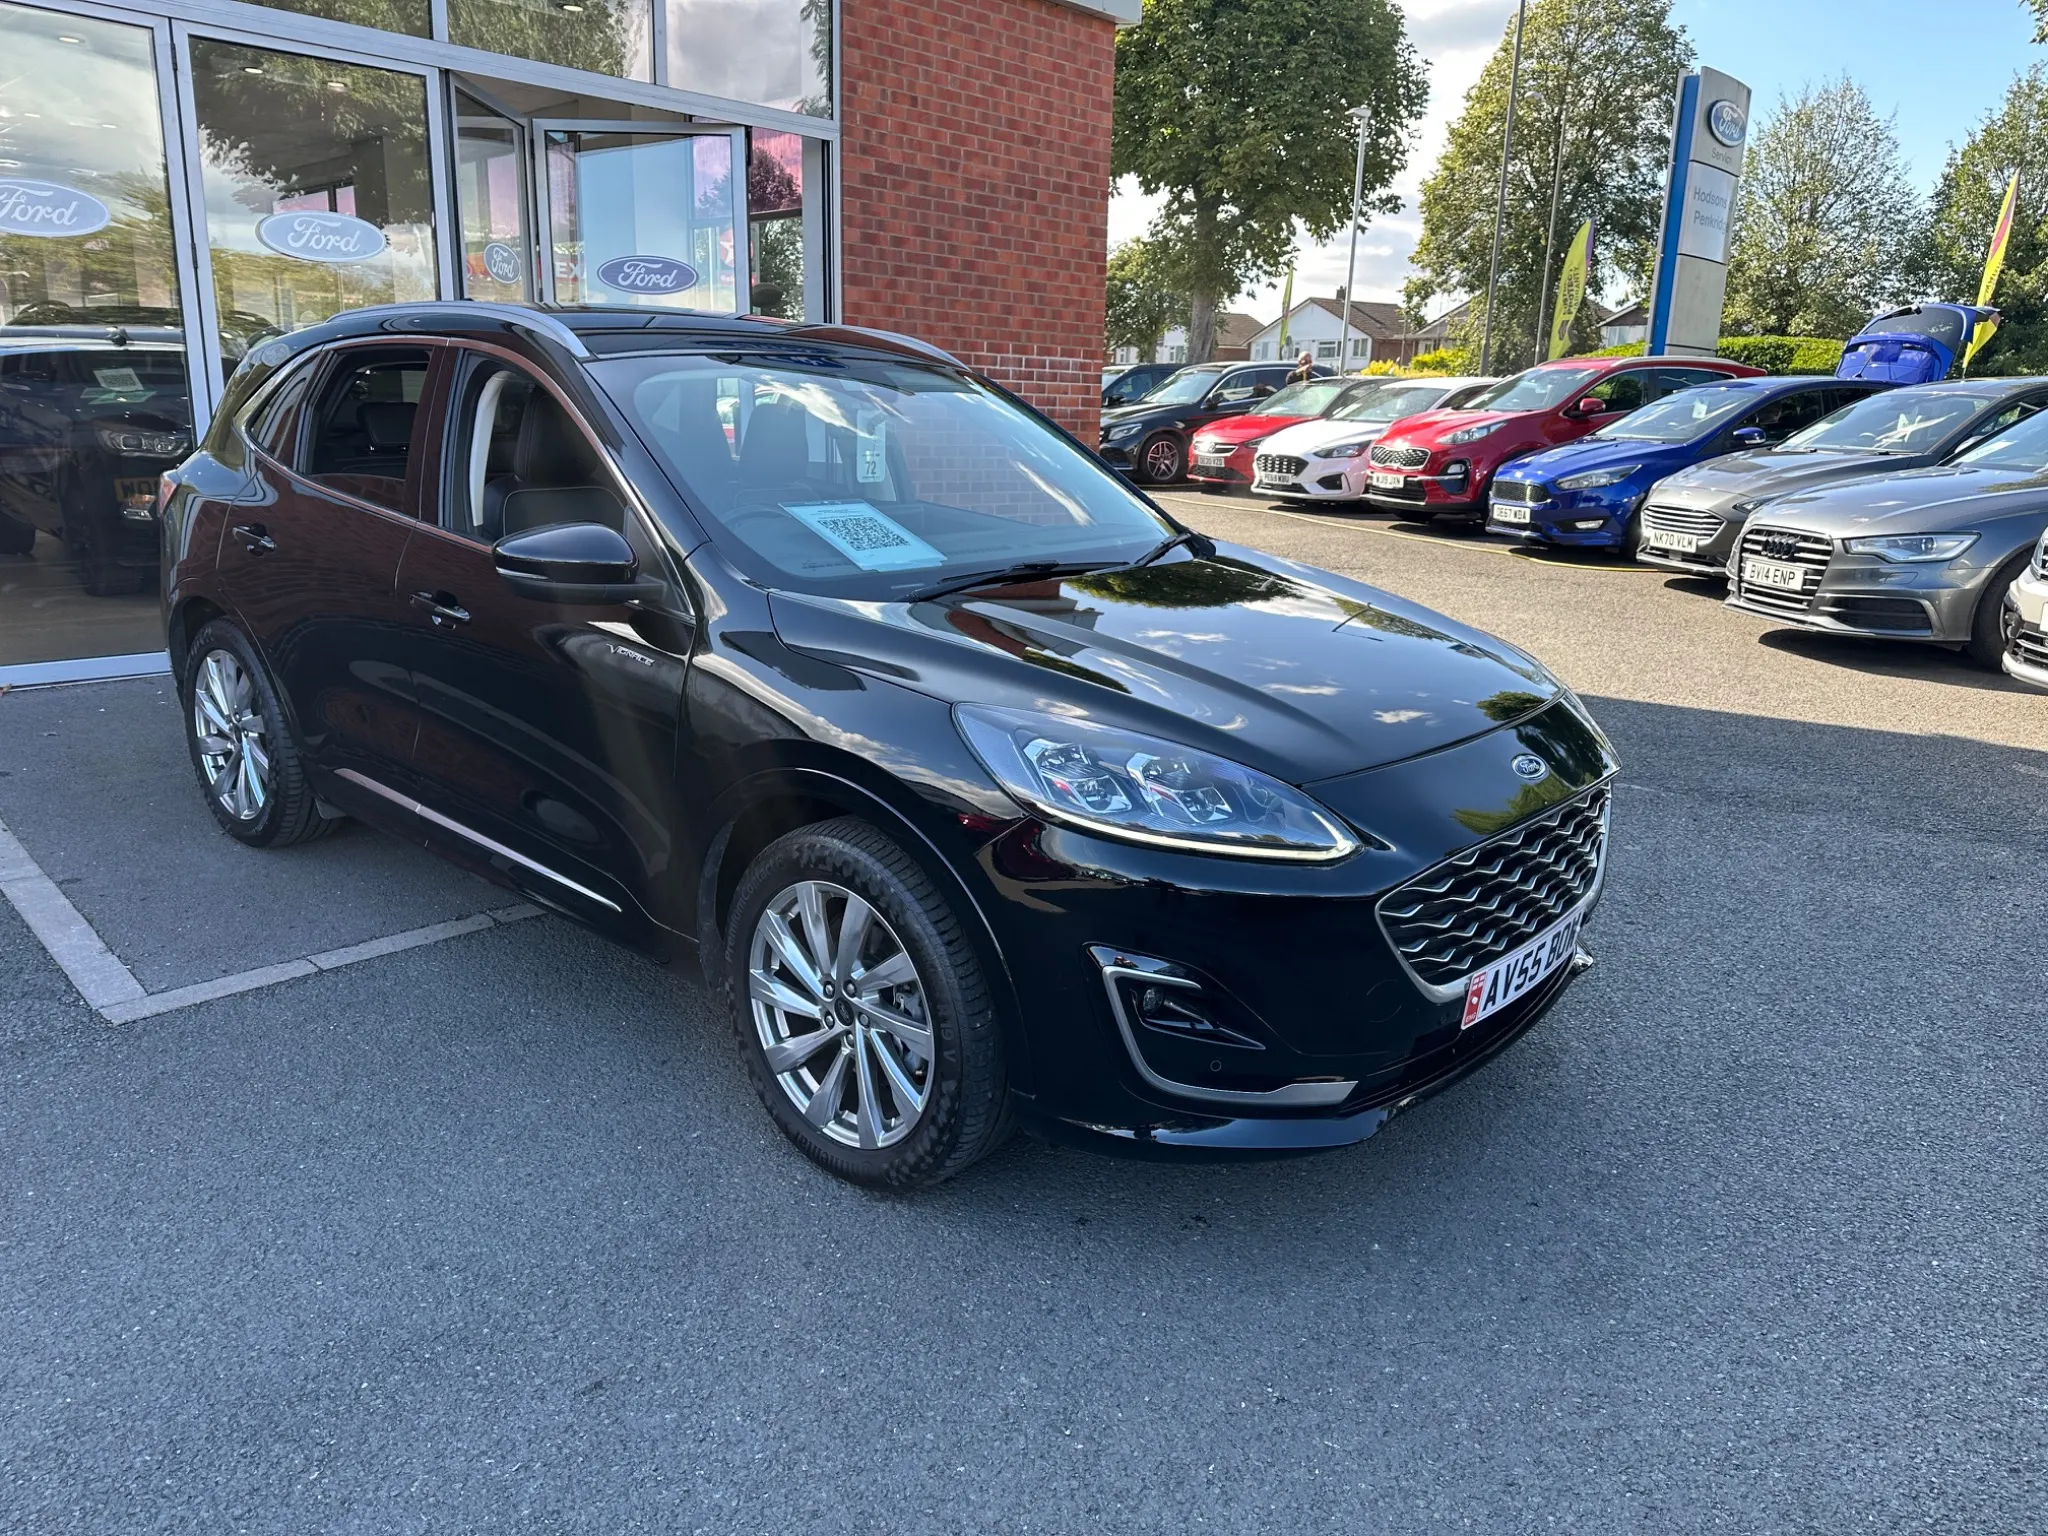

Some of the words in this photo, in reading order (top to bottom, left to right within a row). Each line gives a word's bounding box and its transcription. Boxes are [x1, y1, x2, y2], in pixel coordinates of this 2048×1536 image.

[1719, 107, 1741, 138] Ford
[1693, 186, 1728, 209] Hodsons
[287, 217, 361, 252] Ford
[491, 247, 515, 278] Ford
[618, 261, 677, 288] Ford
[865, 460, 877, 475] 72
[1654, 531, 1675, 546] NK70
[1676, 534, 1693, 549] VLM
[1749, 563, 1771, 581] BV14
[1772, 568, 1796, 585] ENP
[1481, 941, 1547, 1012] AV55
[1465, 1011, 1477, 1022] ENG
